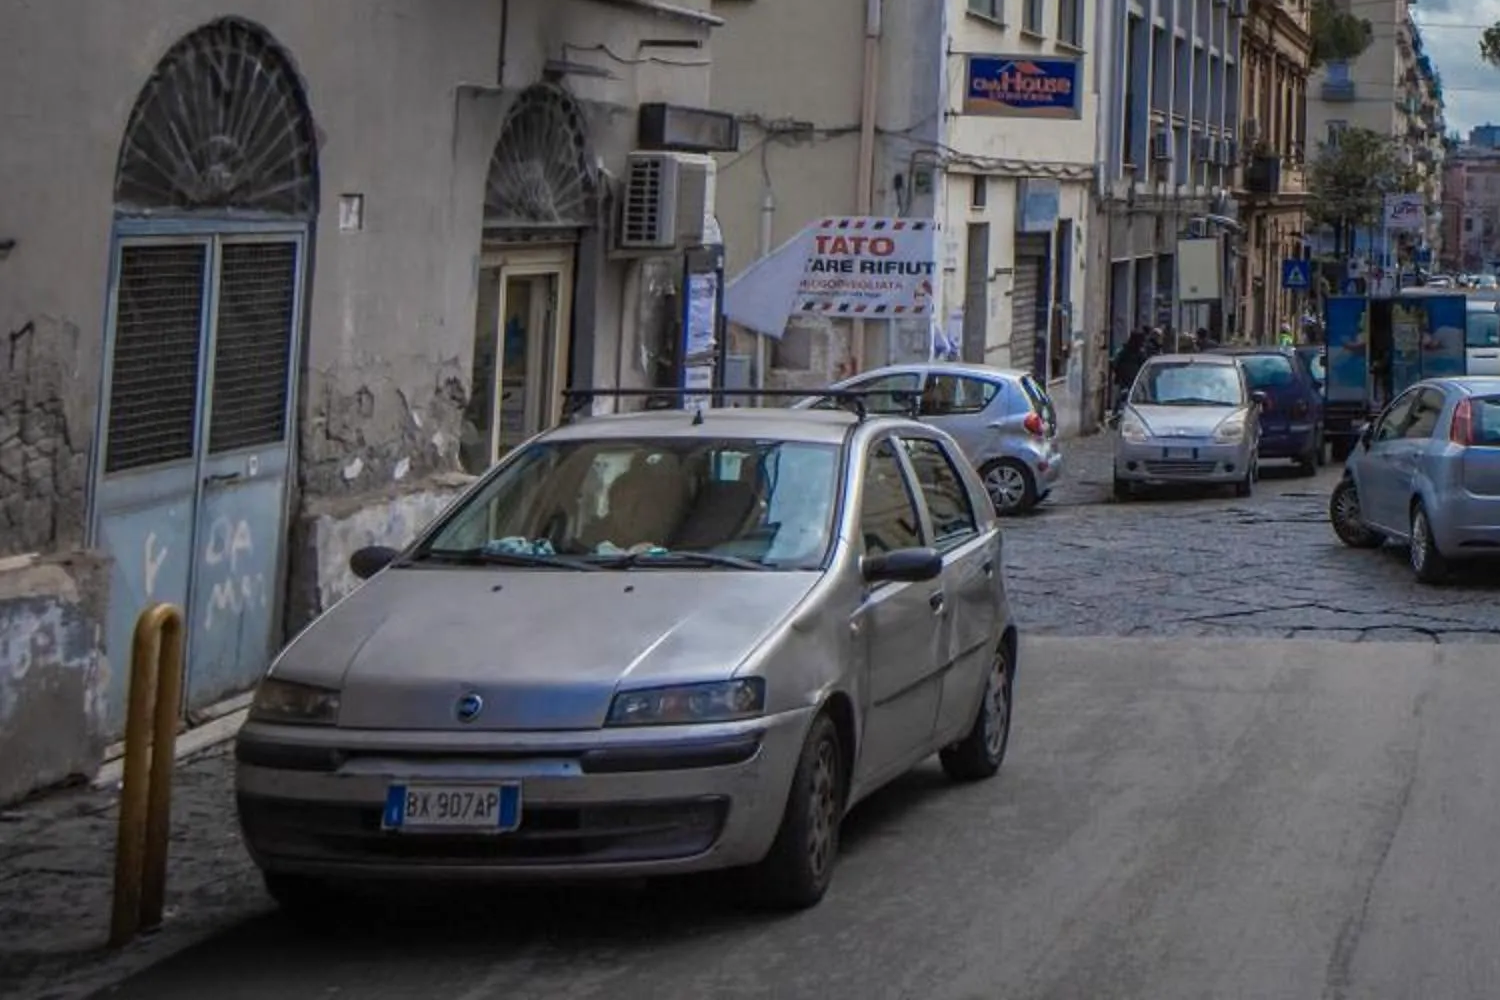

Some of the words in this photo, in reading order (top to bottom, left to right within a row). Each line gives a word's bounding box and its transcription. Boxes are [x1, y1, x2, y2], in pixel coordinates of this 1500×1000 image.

[1001, 71, 1072, 93] House
[815, 235, 895, 256] TATO
[806, 258, 854, 273] ARE
[406, 792, 431, 817] BX
[437, 792, 498, 818] 907AP
